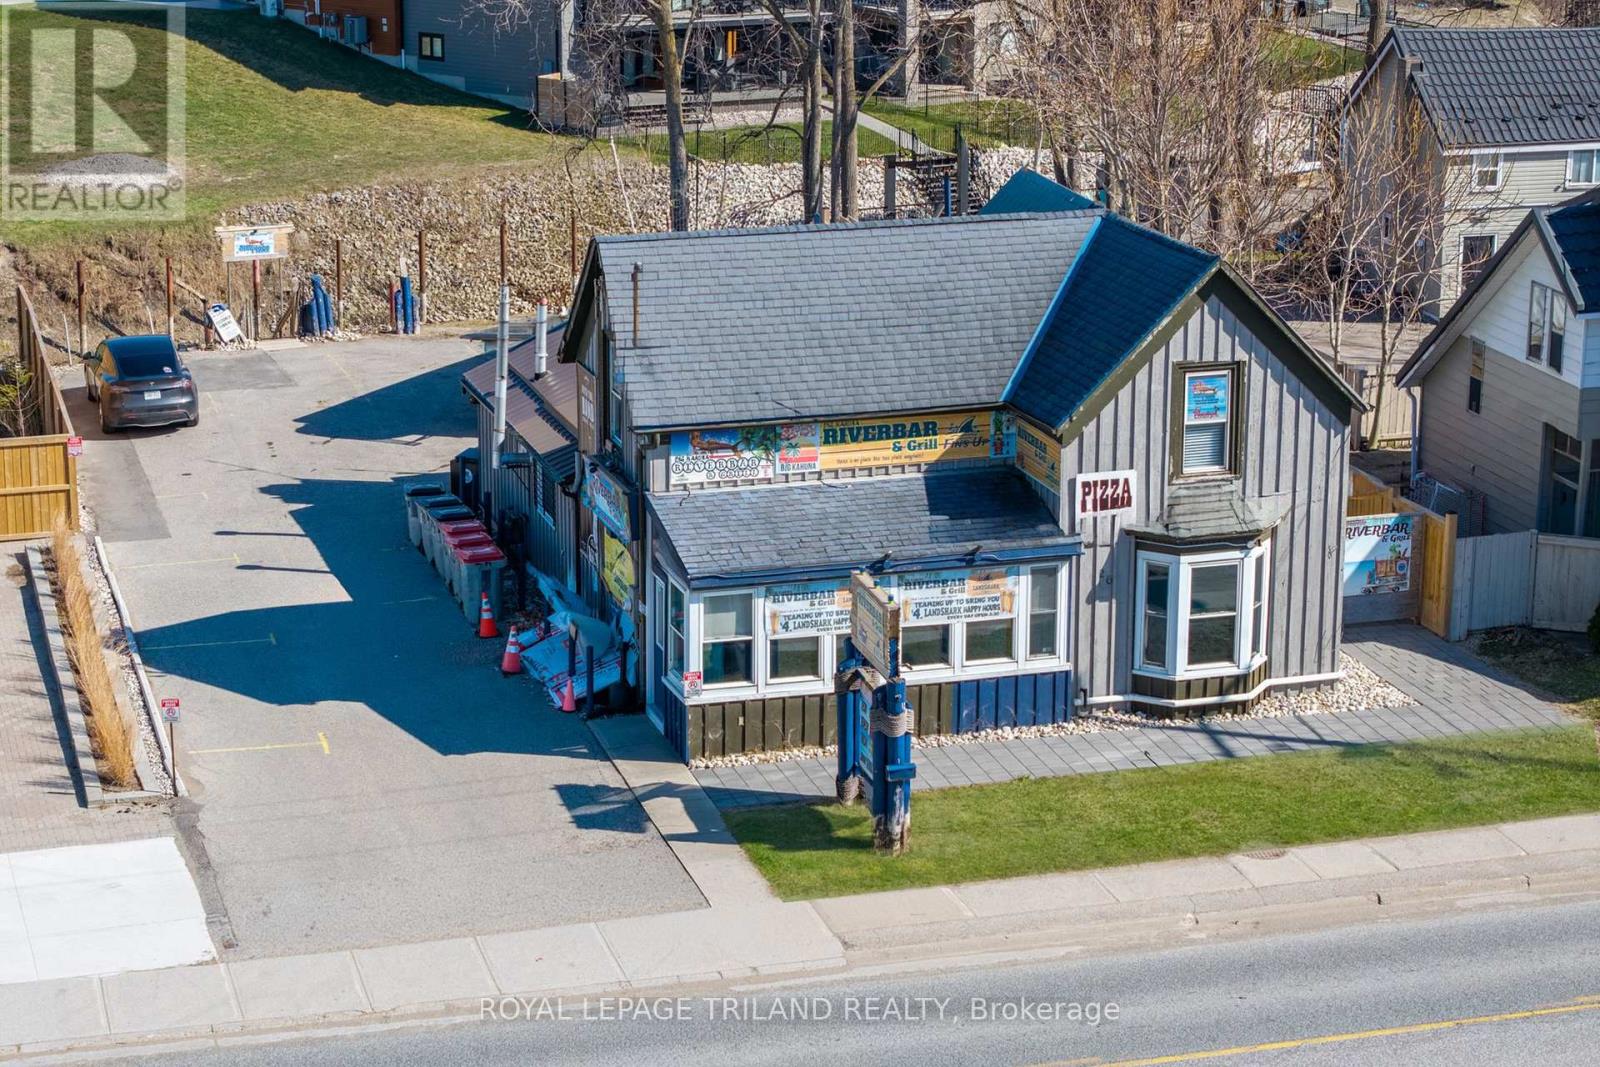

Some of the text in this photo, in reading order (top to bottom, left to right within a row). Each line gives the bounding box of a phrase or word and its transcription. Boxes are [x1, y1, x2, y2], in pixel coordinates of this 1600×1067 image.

[823, 421, 938, 445] RIVERBAR
[891, 437, 938, 452] & Grill
[672, 457, 760, 475] RIVERBAR
[719, 467, 759, 479] GRILL
[1081, 478, 1132, 513] PIZZA
[1346, 522, 1409, 540] RIVERBAR
[903, 578, 966, 591] RIVERBAR
[948, 586, 966, 594] Grill
[772, 590, 835, 604] RIVERBAR
[915, 601, 943, 609] TEAMING
[924, 606, 962, 618] LANDSHARK
[963, 605, 982, 613] HAPPY
[784, 613, 813, 621] TEAMING
[815, 611, 824, 619] UP
[793, 618, 832, 630] LANDSHARK
[833, 617, 850, 625] HAPP
